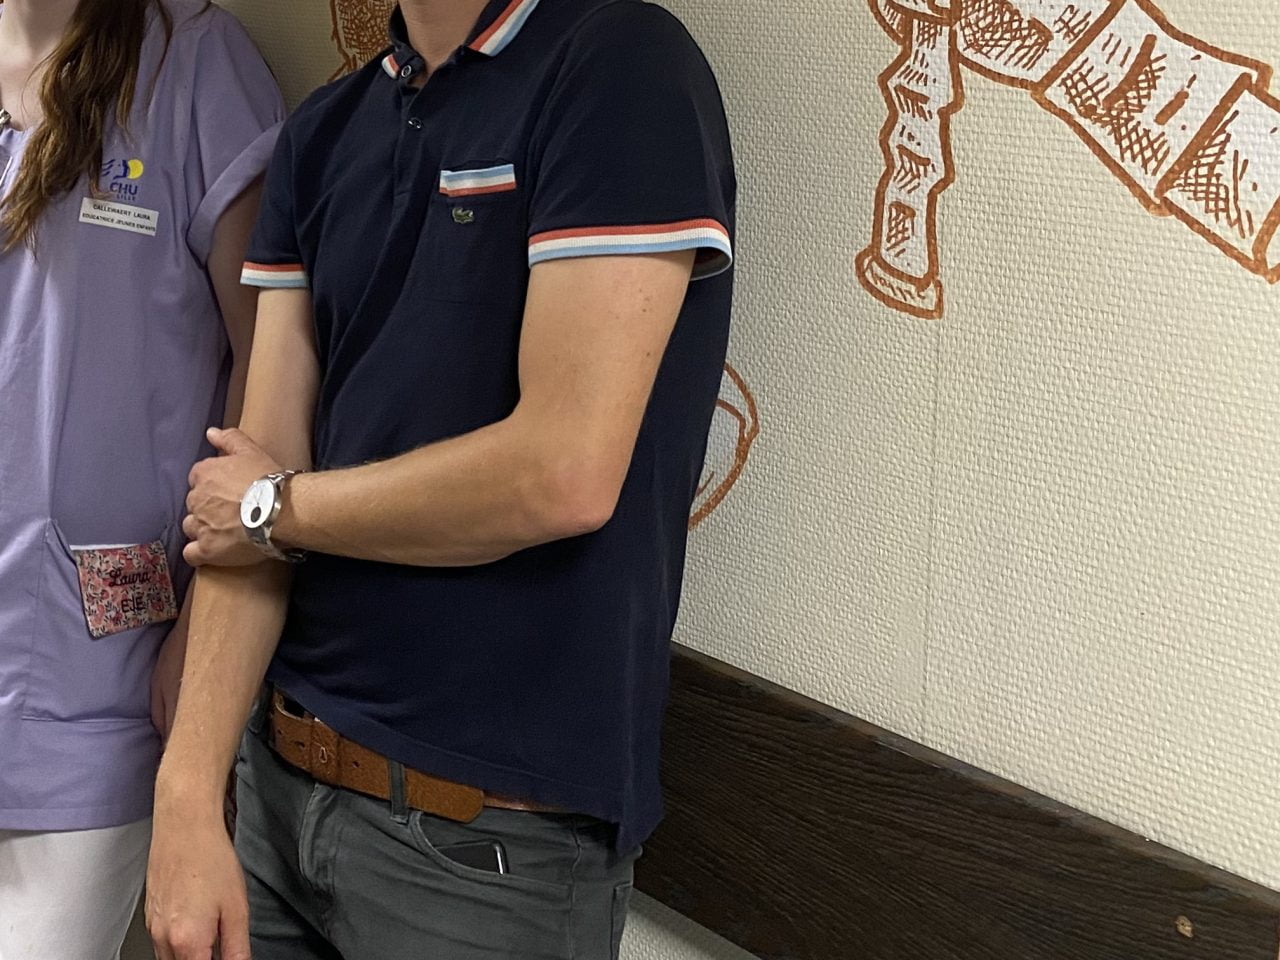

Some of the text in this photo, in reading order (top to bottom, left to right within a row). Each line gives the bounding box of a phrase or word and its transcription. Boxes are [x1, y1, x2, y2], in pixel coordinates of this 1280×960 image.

[110, 182, 138, 196] CHU
[133, 212, 151, 221] LAURA
[108, 567, 151, 587] Laura
[121, 596, 146, 613] EJE
